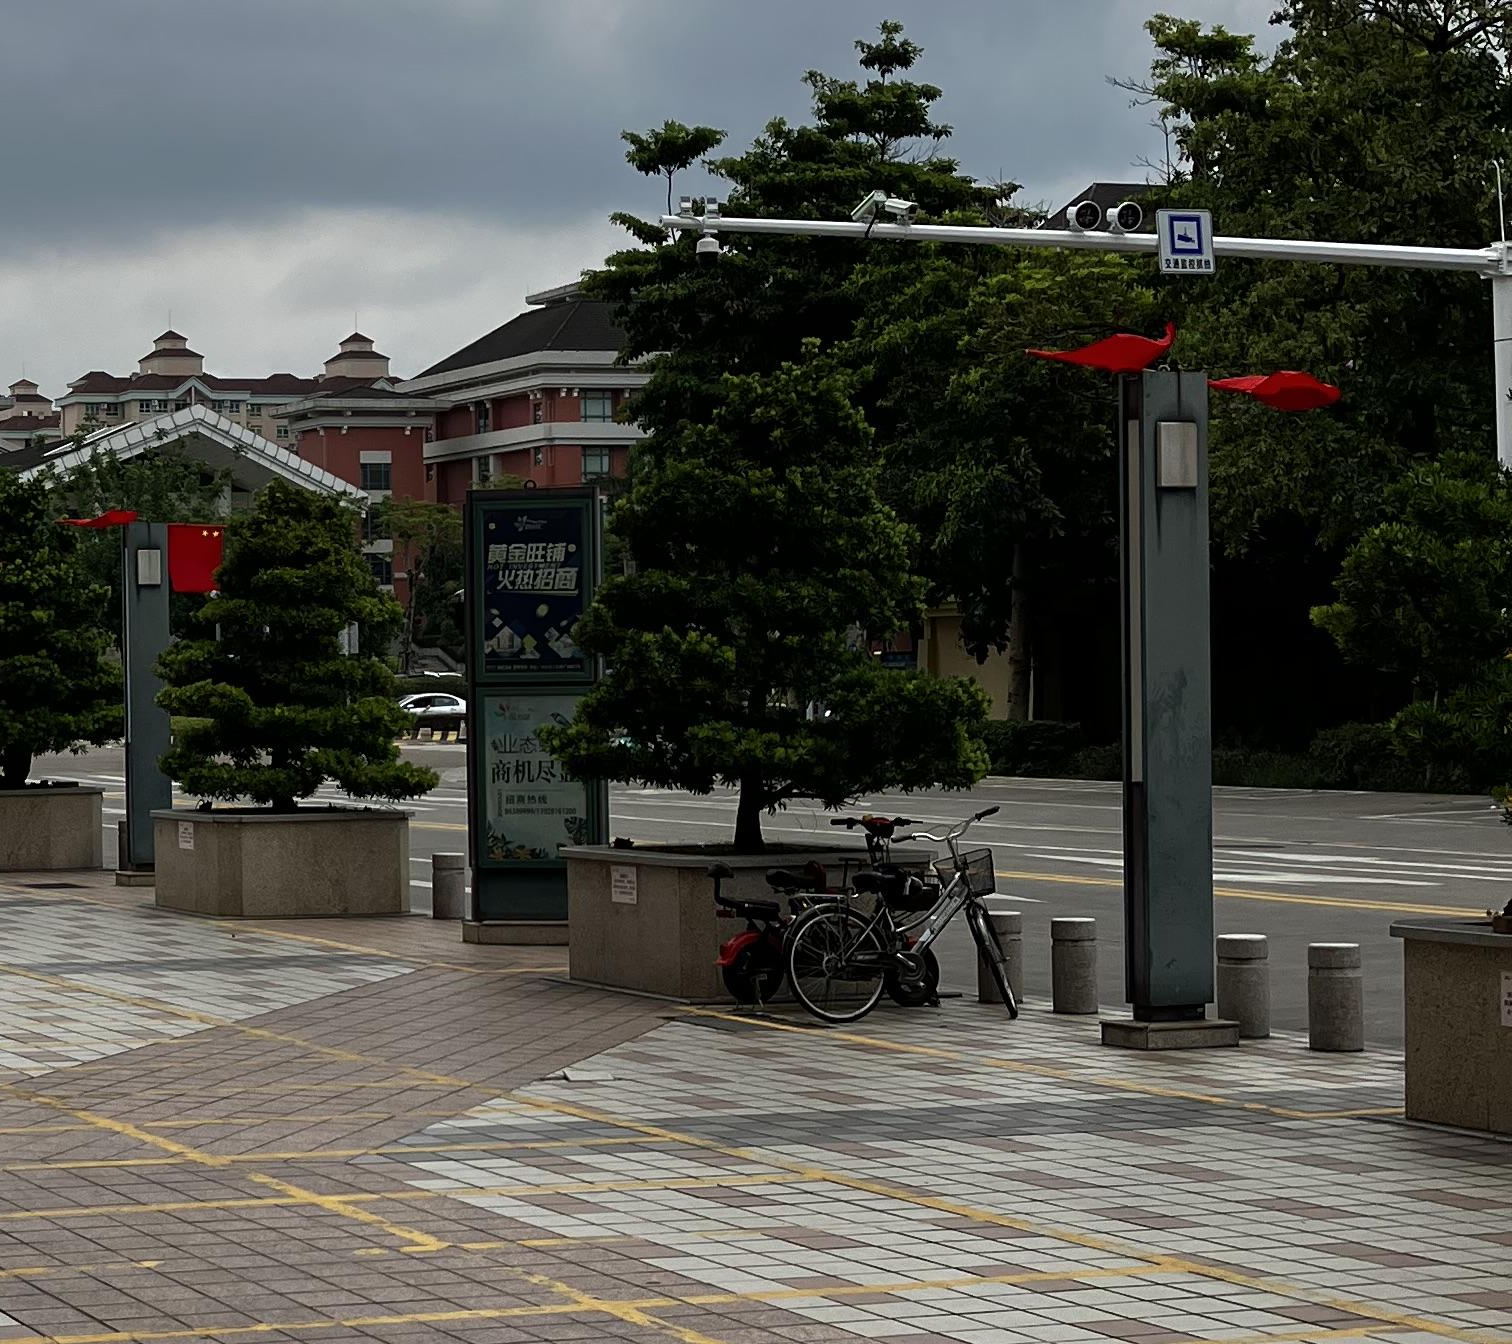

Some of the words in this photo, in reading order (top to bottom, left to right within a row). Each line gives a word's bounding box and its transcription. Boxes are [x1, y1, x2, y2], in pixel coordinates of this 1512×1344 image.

[488, 542, 567, 563] 黄金旺铺
[496, 567, 579, 590] 火热招商
